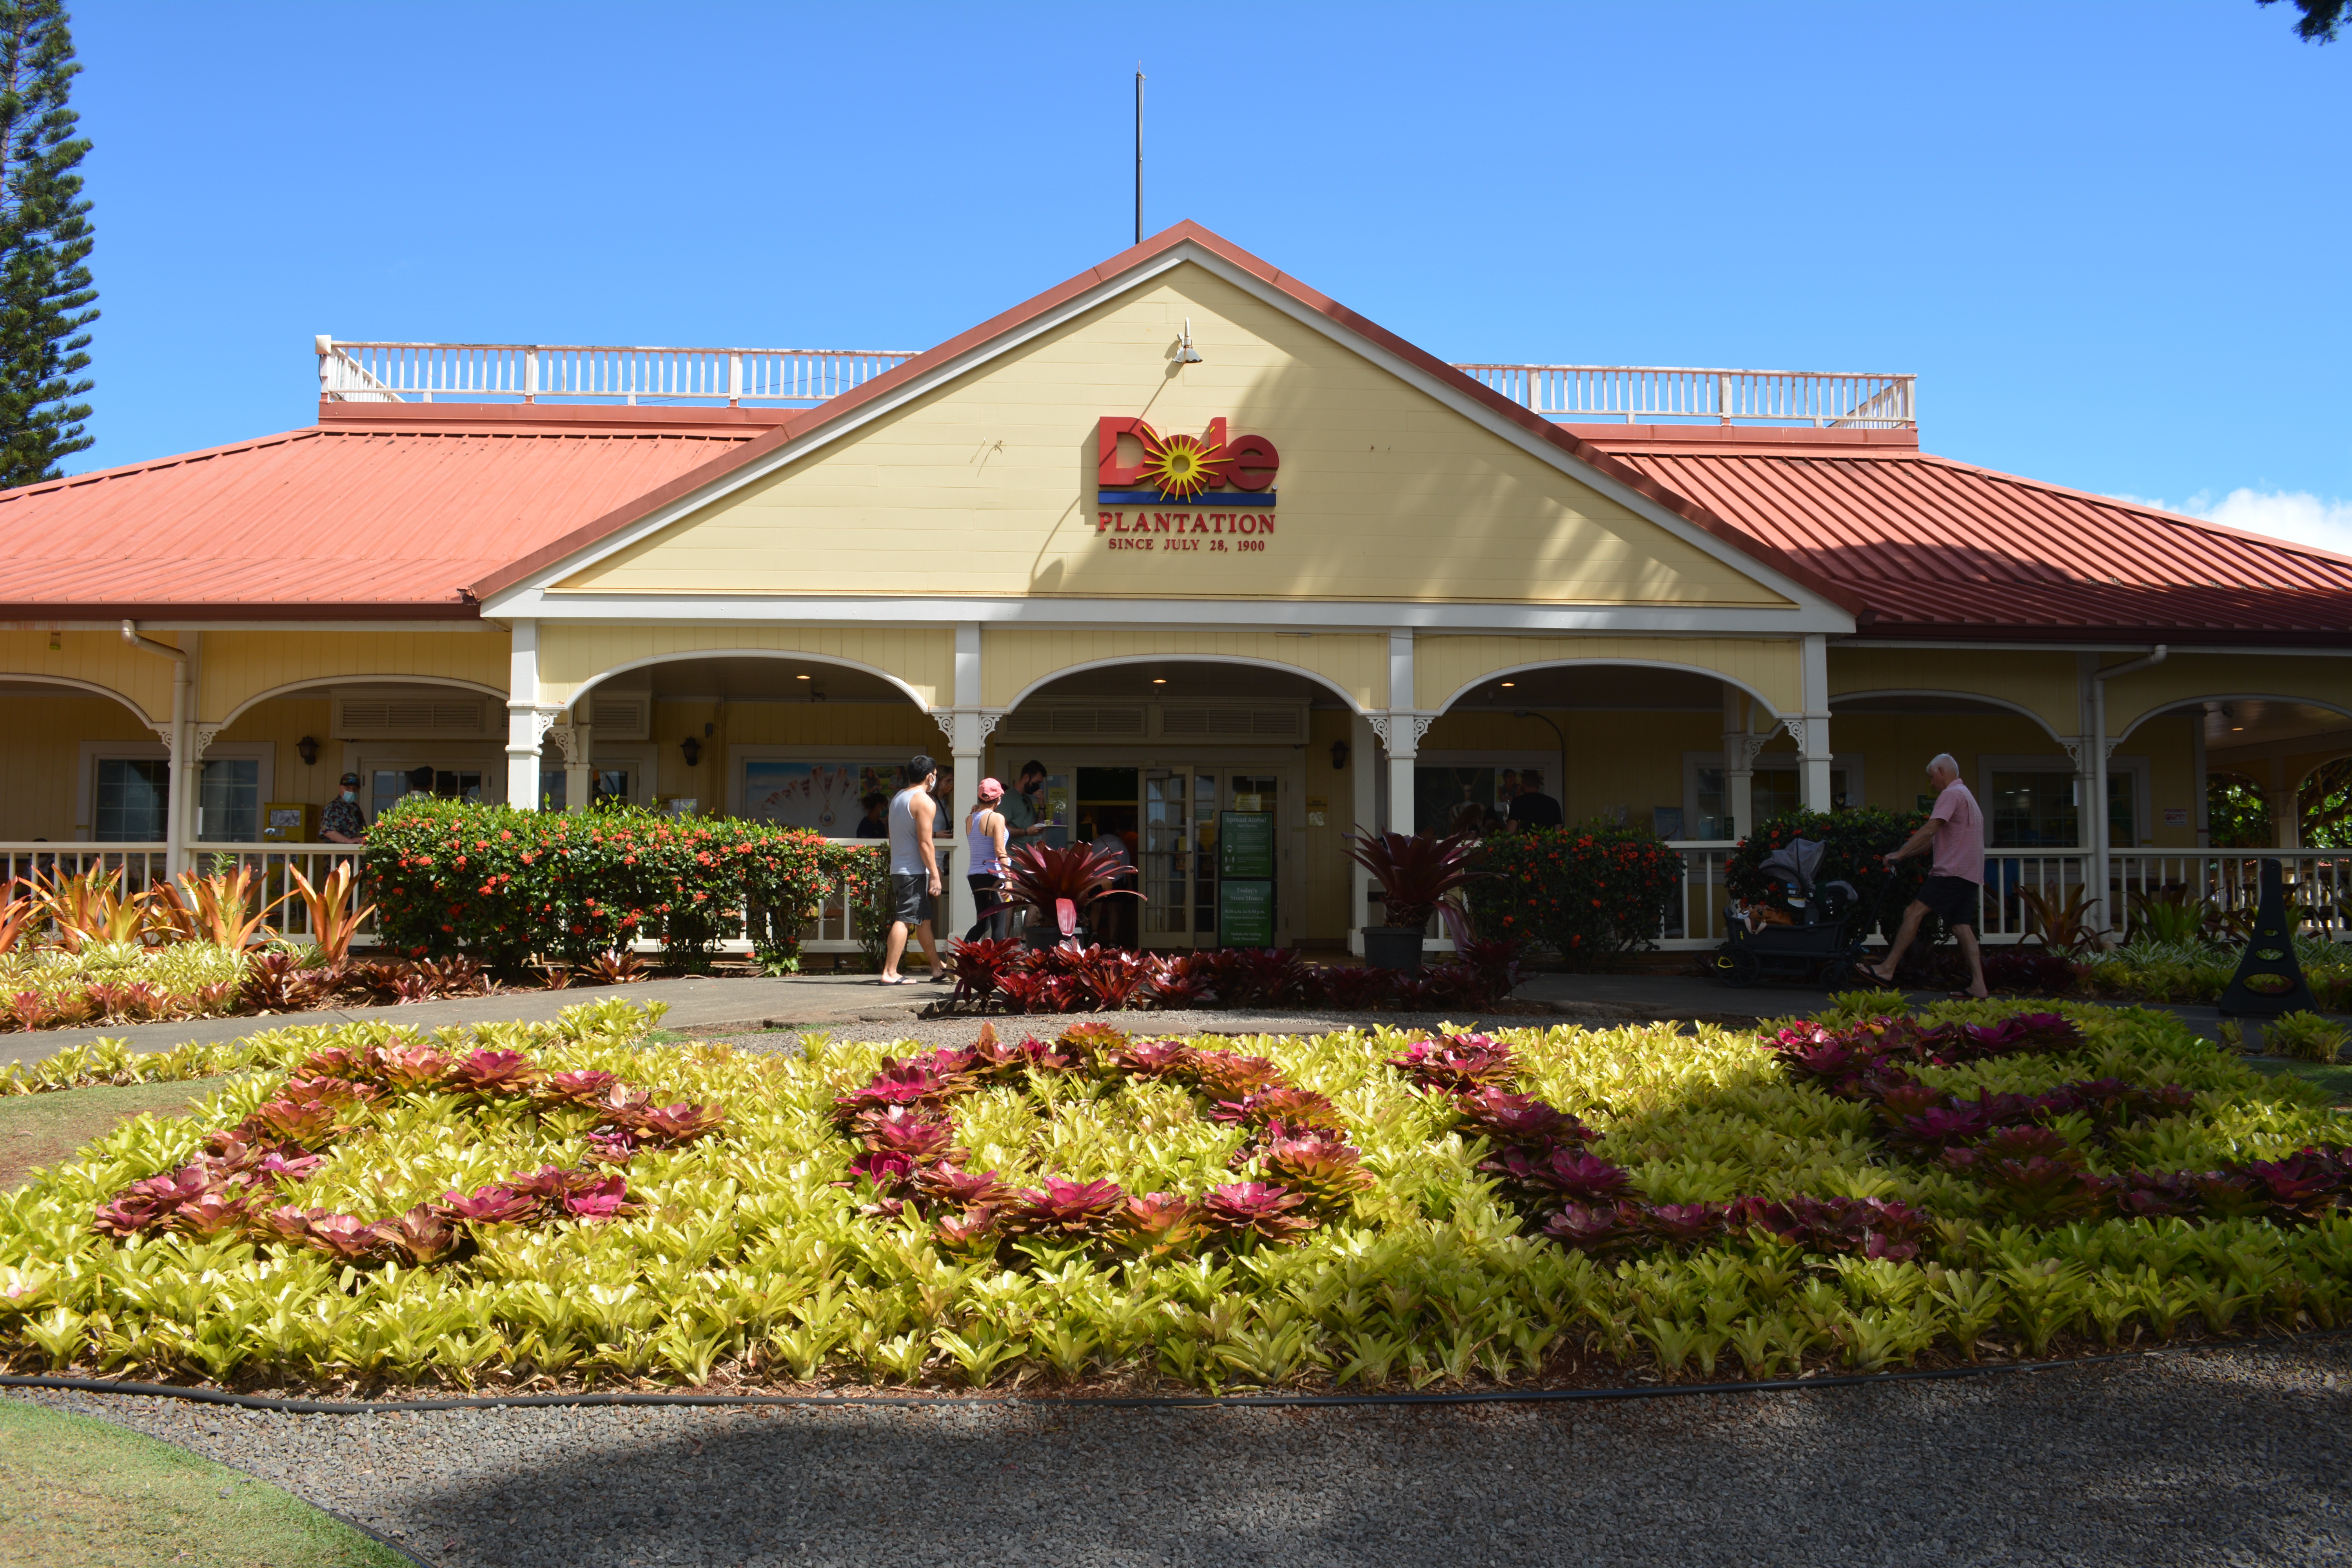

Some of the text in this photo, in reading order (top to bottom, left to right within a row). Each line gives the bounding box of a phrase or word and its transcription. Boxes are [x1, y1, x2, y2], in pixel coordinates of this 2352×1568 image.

[1099, 416, 1280, 495] Dole
[1098, 512, 1276, 534] PLANTATION
[1109, 538, 1265, 552] SINCE JULY 28, 1900
